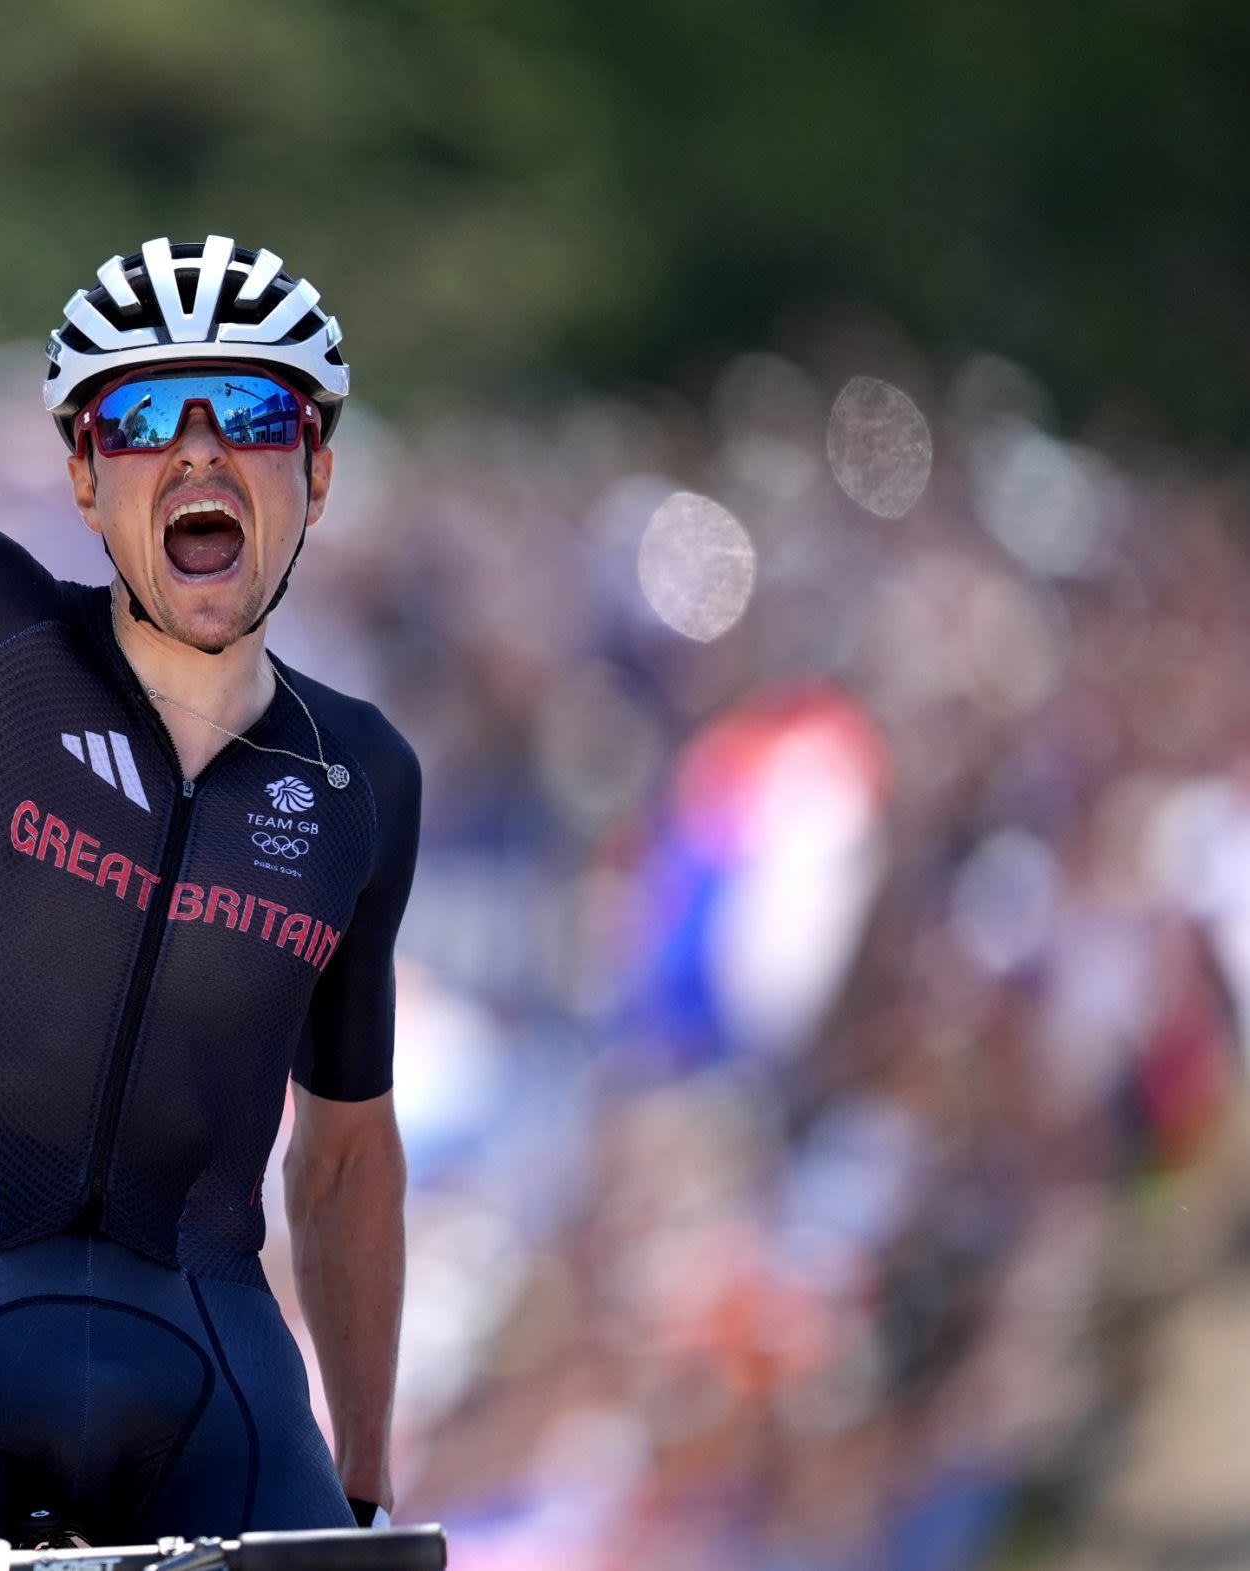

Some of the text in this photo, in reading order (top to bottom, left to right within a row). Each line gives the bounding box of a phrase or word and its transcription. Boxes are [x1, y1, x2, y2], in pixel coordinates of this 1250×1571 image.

[247, 813, 319, 835] TEAM GB
[253, 859, 279, 872] PARIS
[11, 800, 341, 972] GREAT BRITAIN
